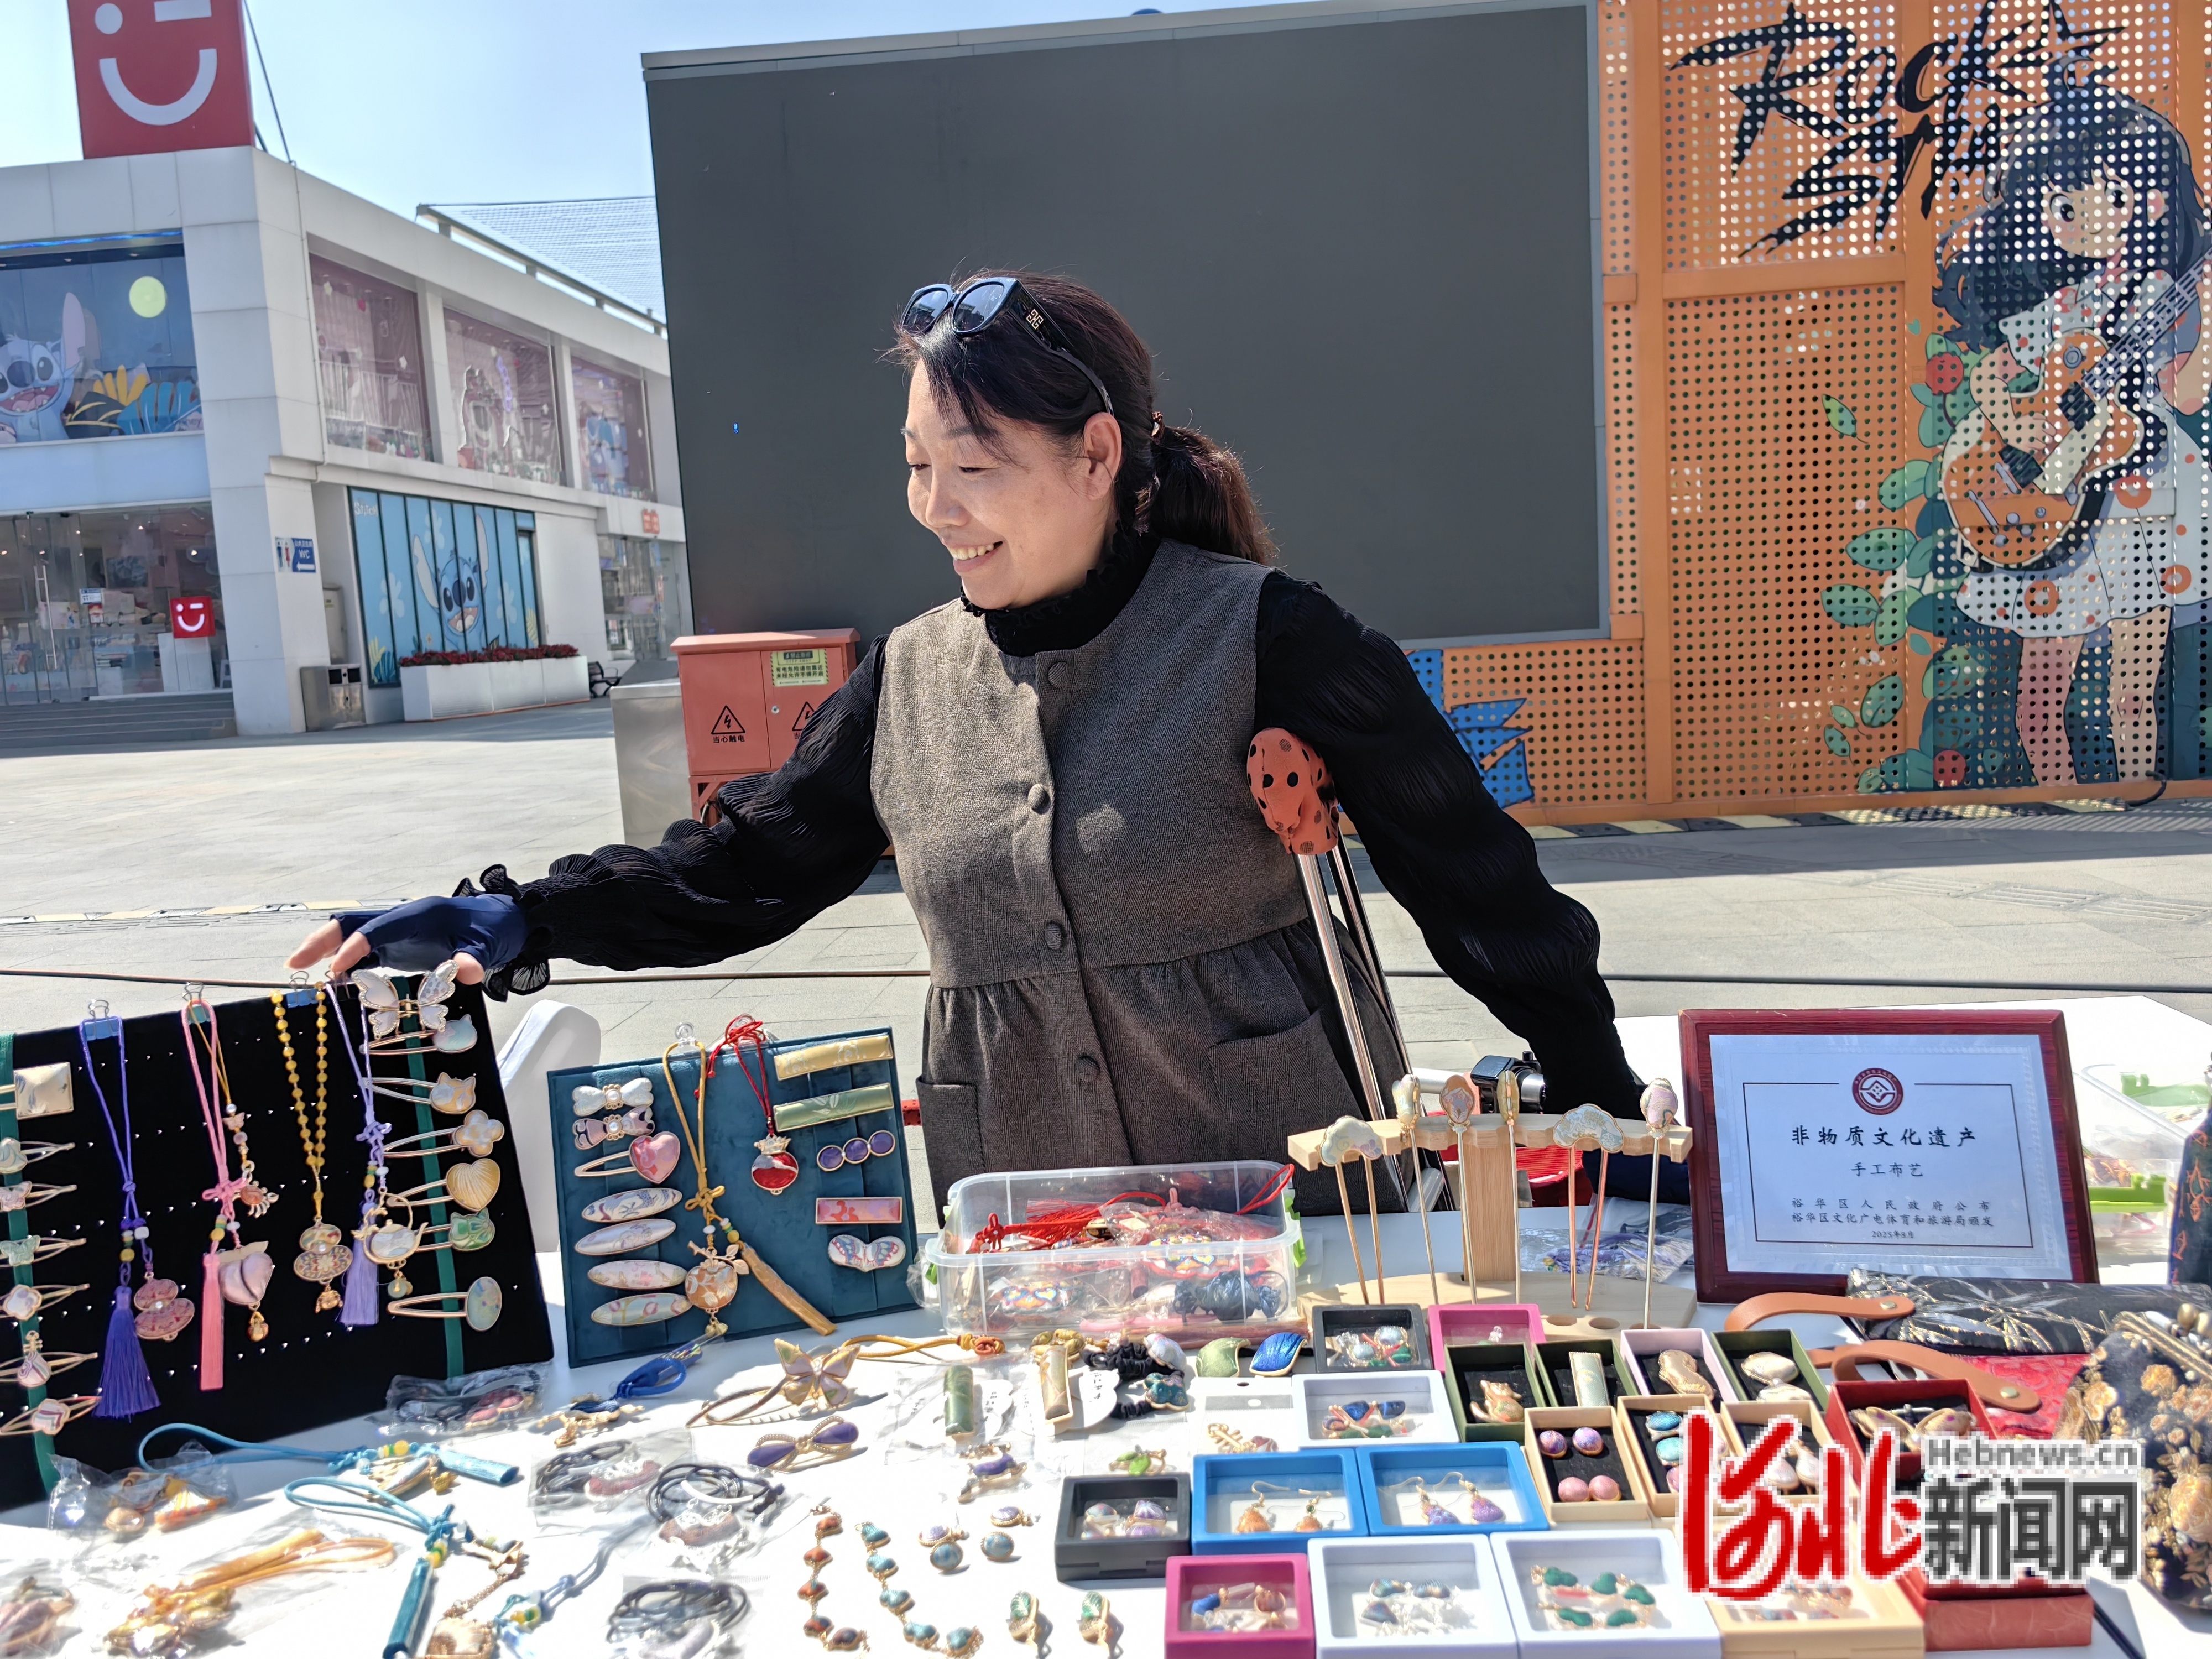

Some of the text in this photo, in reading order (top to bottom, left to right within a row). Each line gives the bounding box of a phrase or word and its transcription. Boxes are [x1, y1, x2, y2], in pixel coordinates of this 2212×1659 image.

[299, 548, 311, 559] WC
[713, 735, 745, 743] 当心触电
[1791, 1125, 1976, 1147] 非物质文化遗产
[1851, 1162, 1923, 1177] 手工布艺
[1791, 1198, 1990, 1212] 裕华区人民政府公布
[1791, 1212, 1994, 1227] 裕华区文化广电体育和旅游局颁发
[1871, 1230, 1914, 1239] 2025年8月
